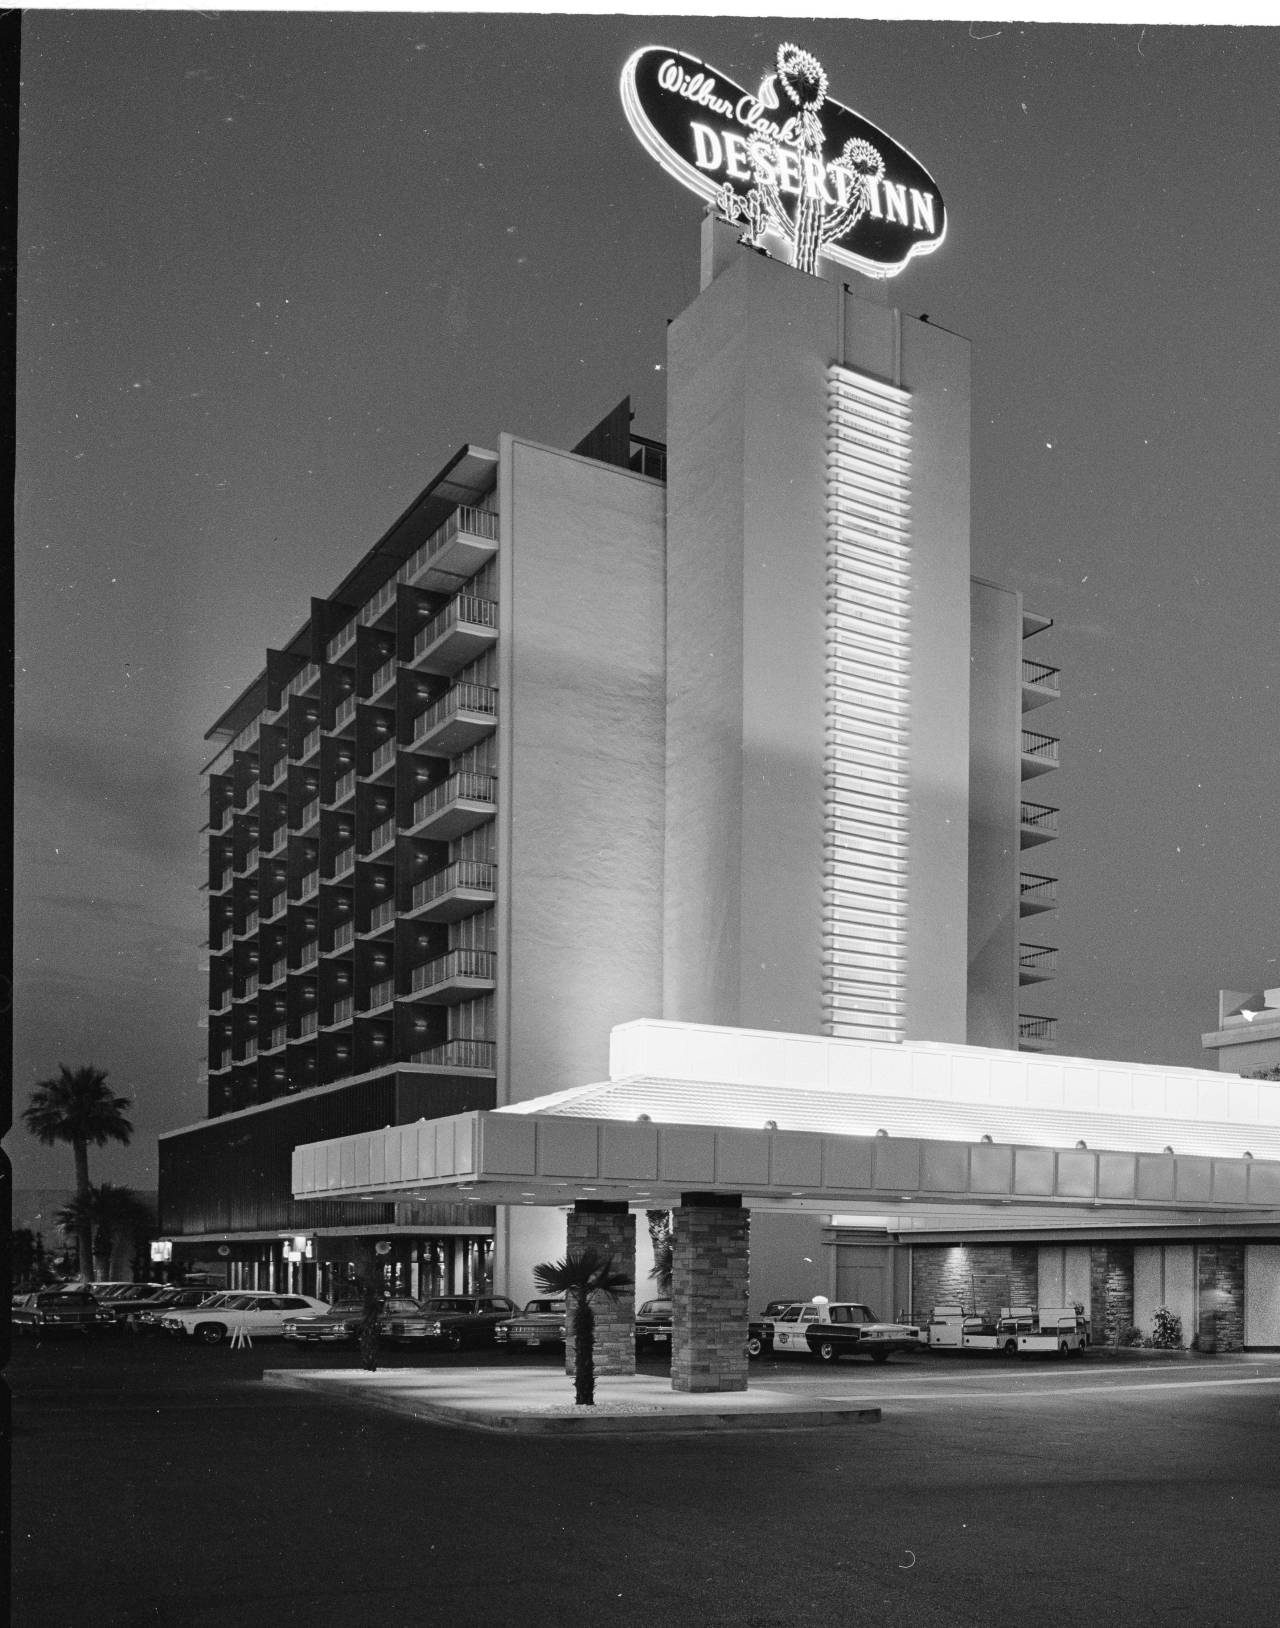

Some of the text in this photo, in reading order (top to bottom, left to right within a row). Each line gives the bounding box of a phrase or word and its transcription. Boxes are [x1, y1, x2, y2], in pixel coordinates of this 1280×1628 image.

[657, 58, 733, 118] Wilbur
[690, 121, 937, 234] DESERT INN
